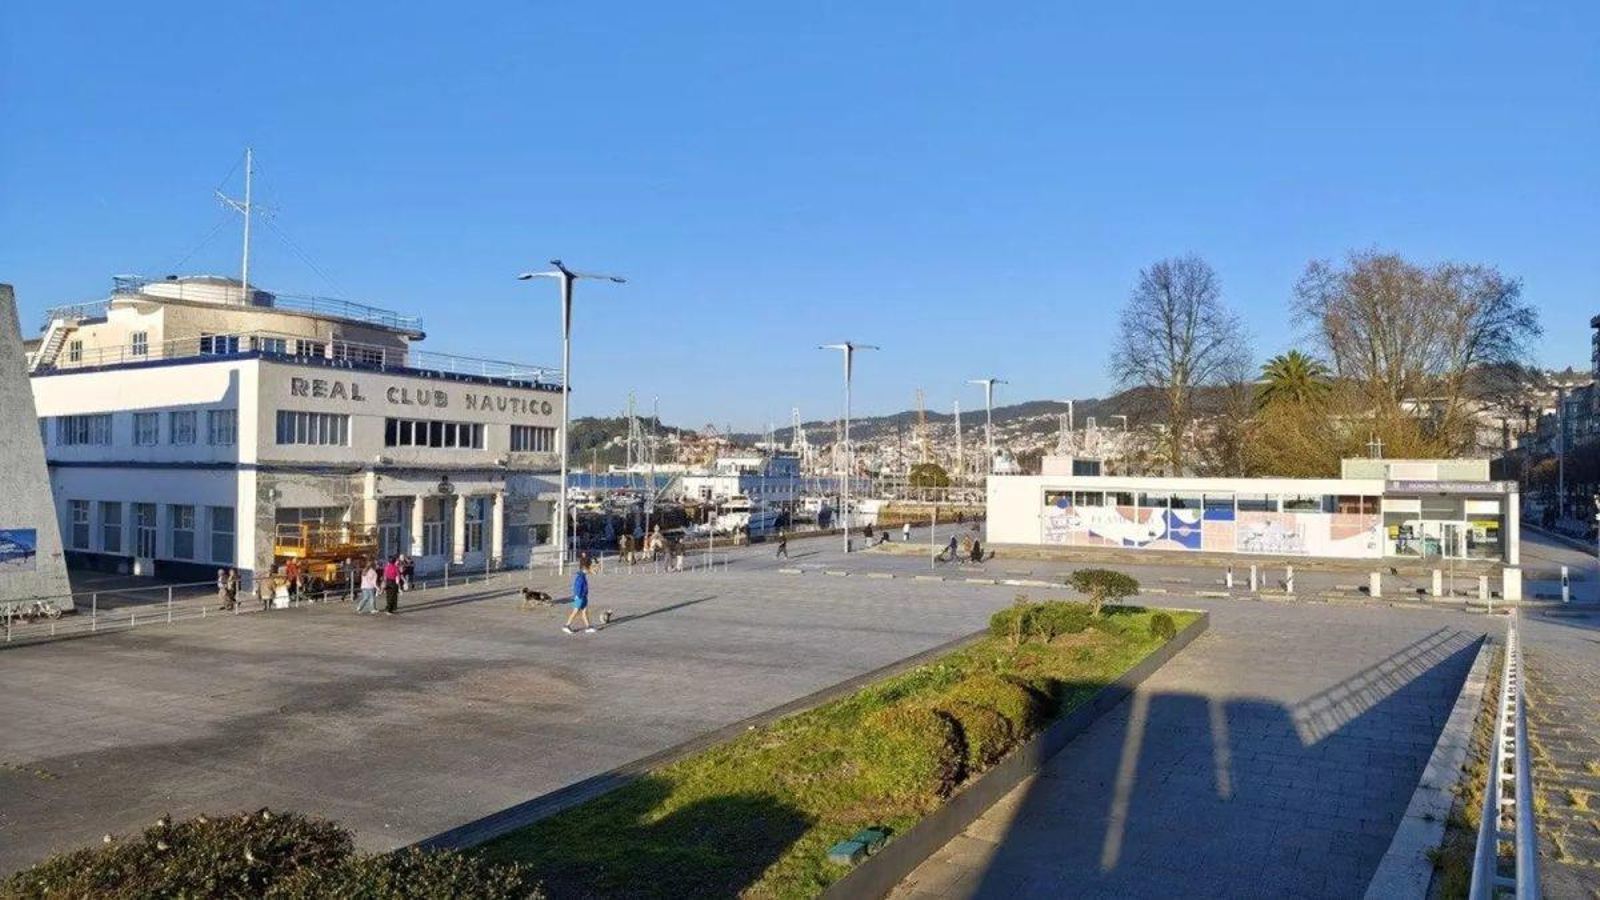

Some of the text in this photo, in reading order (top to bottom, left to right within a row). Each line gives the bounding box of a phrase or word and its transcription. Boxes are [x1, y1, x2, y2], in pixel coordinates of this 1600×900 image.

[291, 376, 553, 416] REAL CLUB NAUTICO
